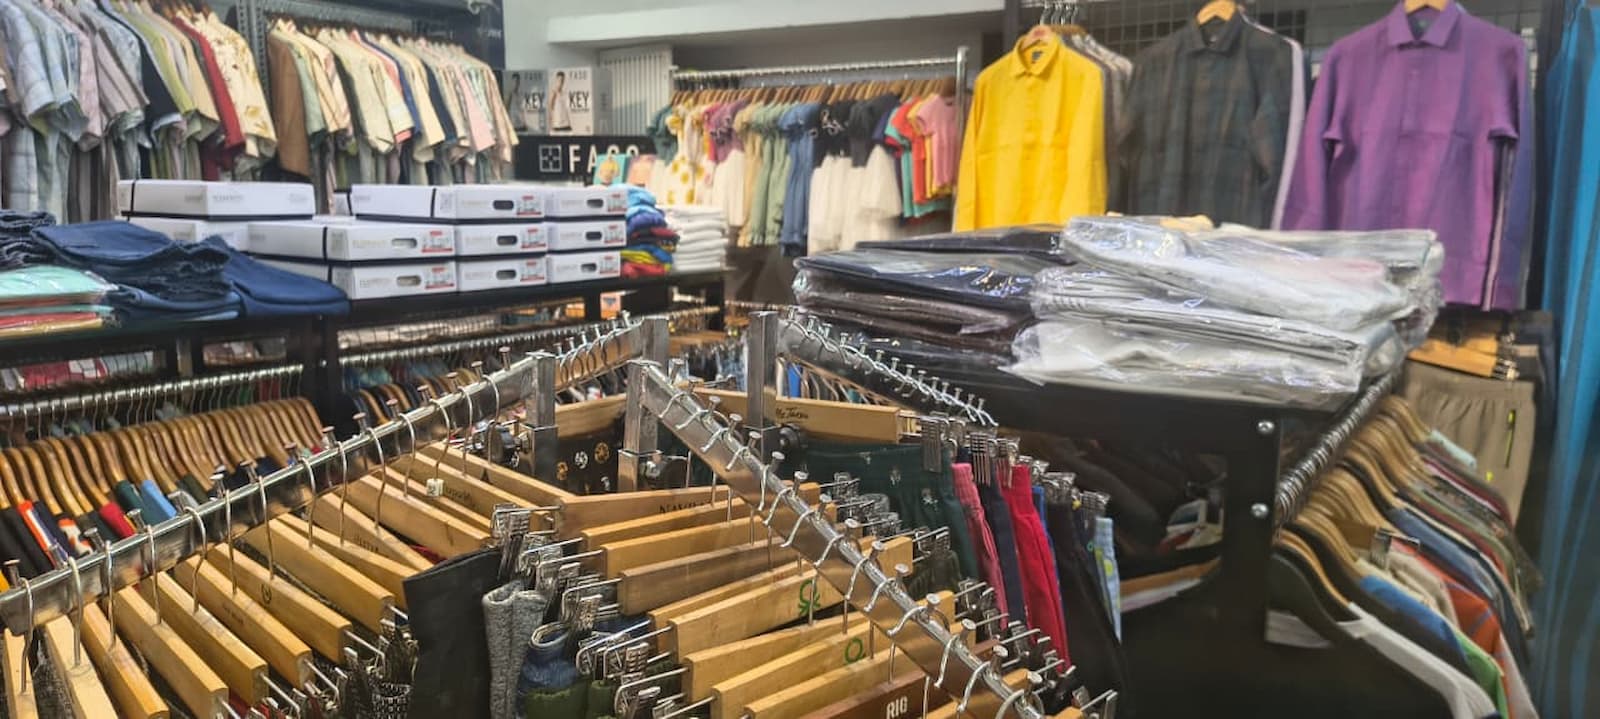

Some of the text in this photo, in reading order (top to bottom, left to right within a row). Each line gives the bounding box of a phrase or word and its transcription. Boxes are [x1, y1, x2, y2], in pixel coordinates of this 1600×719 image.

[524, 92, 545, 109] KEY
[569, 91, 589, 107] KEY
[886, 695, 909, 719] RIG
